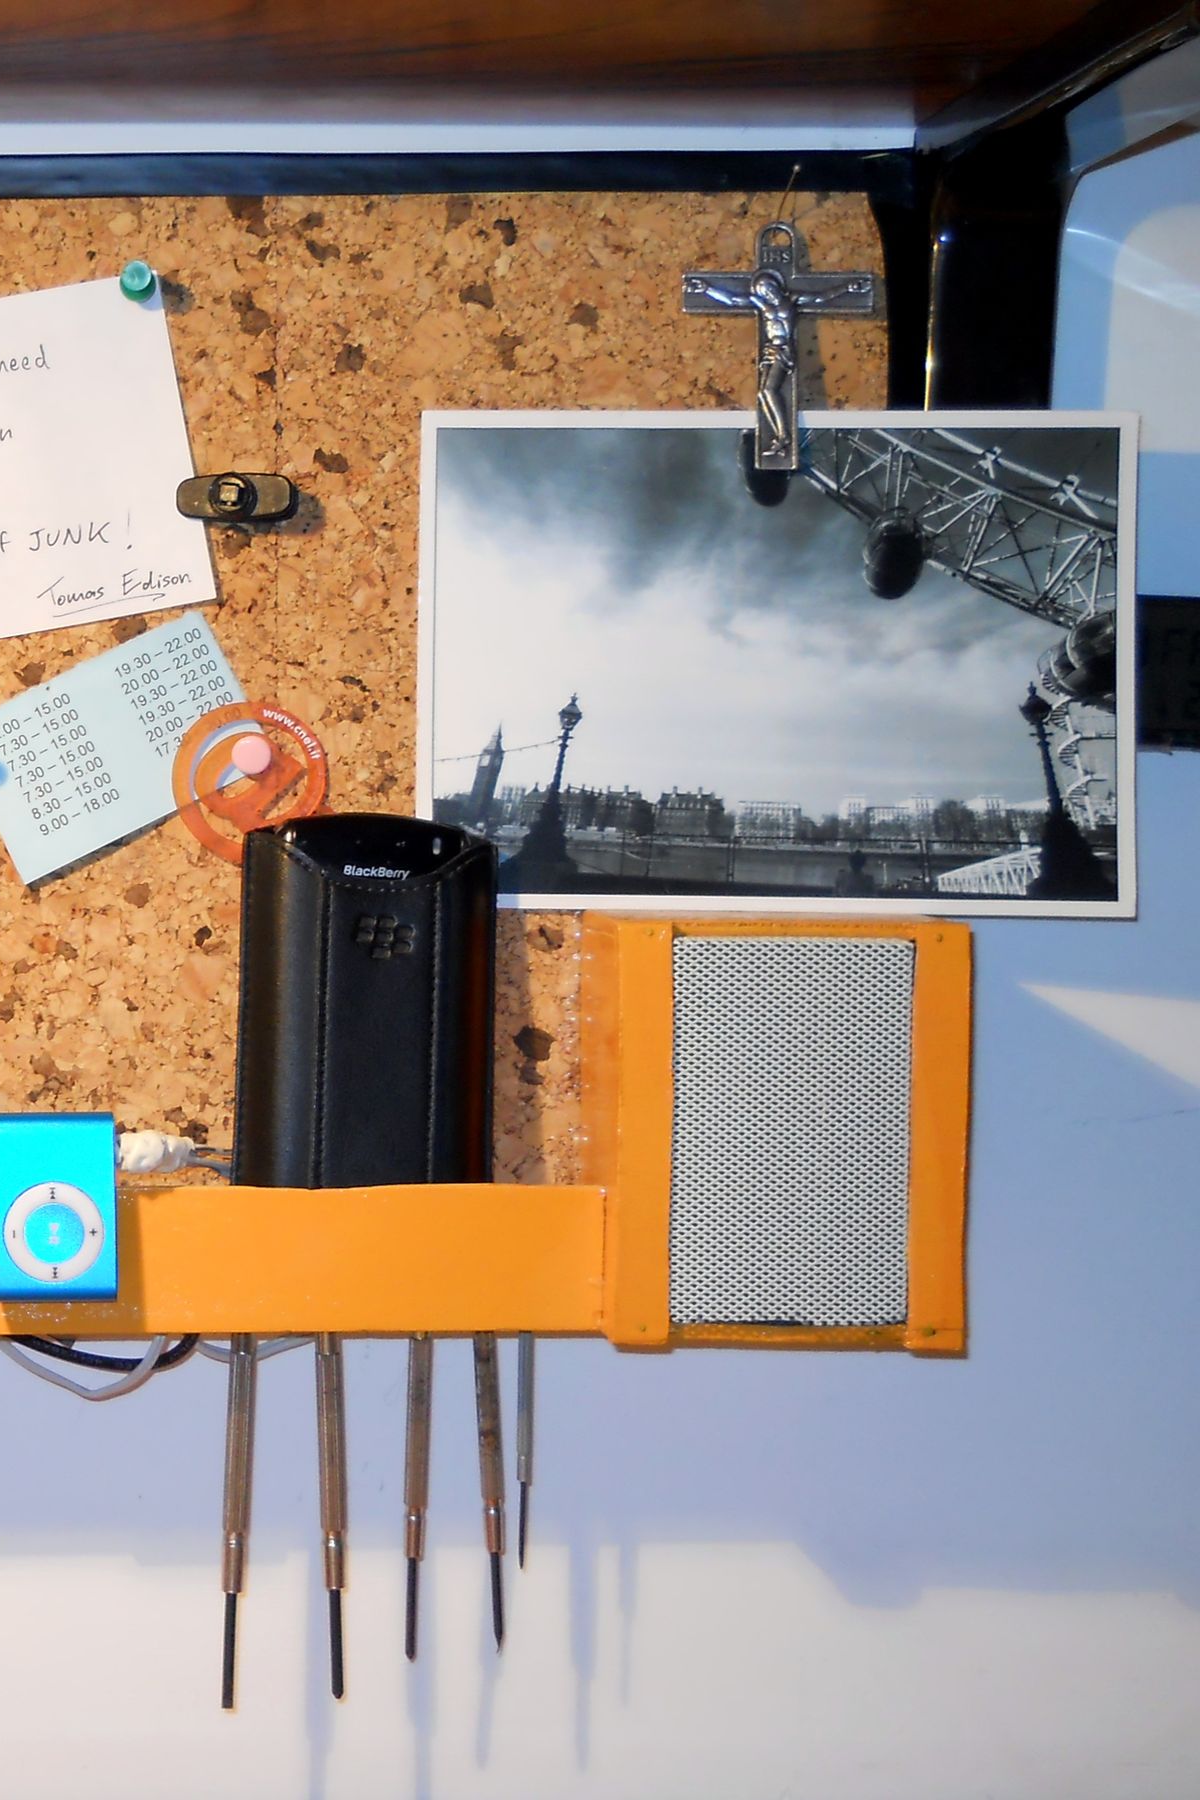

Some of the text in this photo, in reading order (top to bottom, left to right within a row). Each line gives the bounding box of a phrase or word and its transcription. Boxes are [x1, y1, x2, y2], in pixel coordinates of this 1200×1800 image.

[29, 521, 111, 552] JUNK
[36, 568, 192, 607] Tomas Edison
[113, 654, 152, 679] 19.30
[164, 627, 202, 652] 22.00
[121, 670, 160, 695] 20.00
[172, 643, 210, 669] 22.00
[34, 693, 71, 718] 15.00
[129, 685, 168, 710] 19.30
[180, 659, 218, 685] 22.00
[138, 701, 176, 726] 19.30
[188, 675, 226, 701] 22.00
[42, 709, 79, 734] 15.00
[145, 717, 184, 743] 20.00
[6, 750, 37, 773] 7.30
[50, 724, 87, 750] 15.00
[14, 765, 45, 788] 7.30
[58, 740, 96, 765] 15.00
[154, 733, 187, 758] 17.3
[23, 781, 53, 804] 7.30
[66, 756, 104, 781] 15.00
[31, 796, 61, 819] 8.30
[74, 772, 112, 797] 15.00
[39, 812, 70, 835] 9.00
[83, 787, 120, 813] 18.00
[343, 865, 410, 880] BlackBerry
